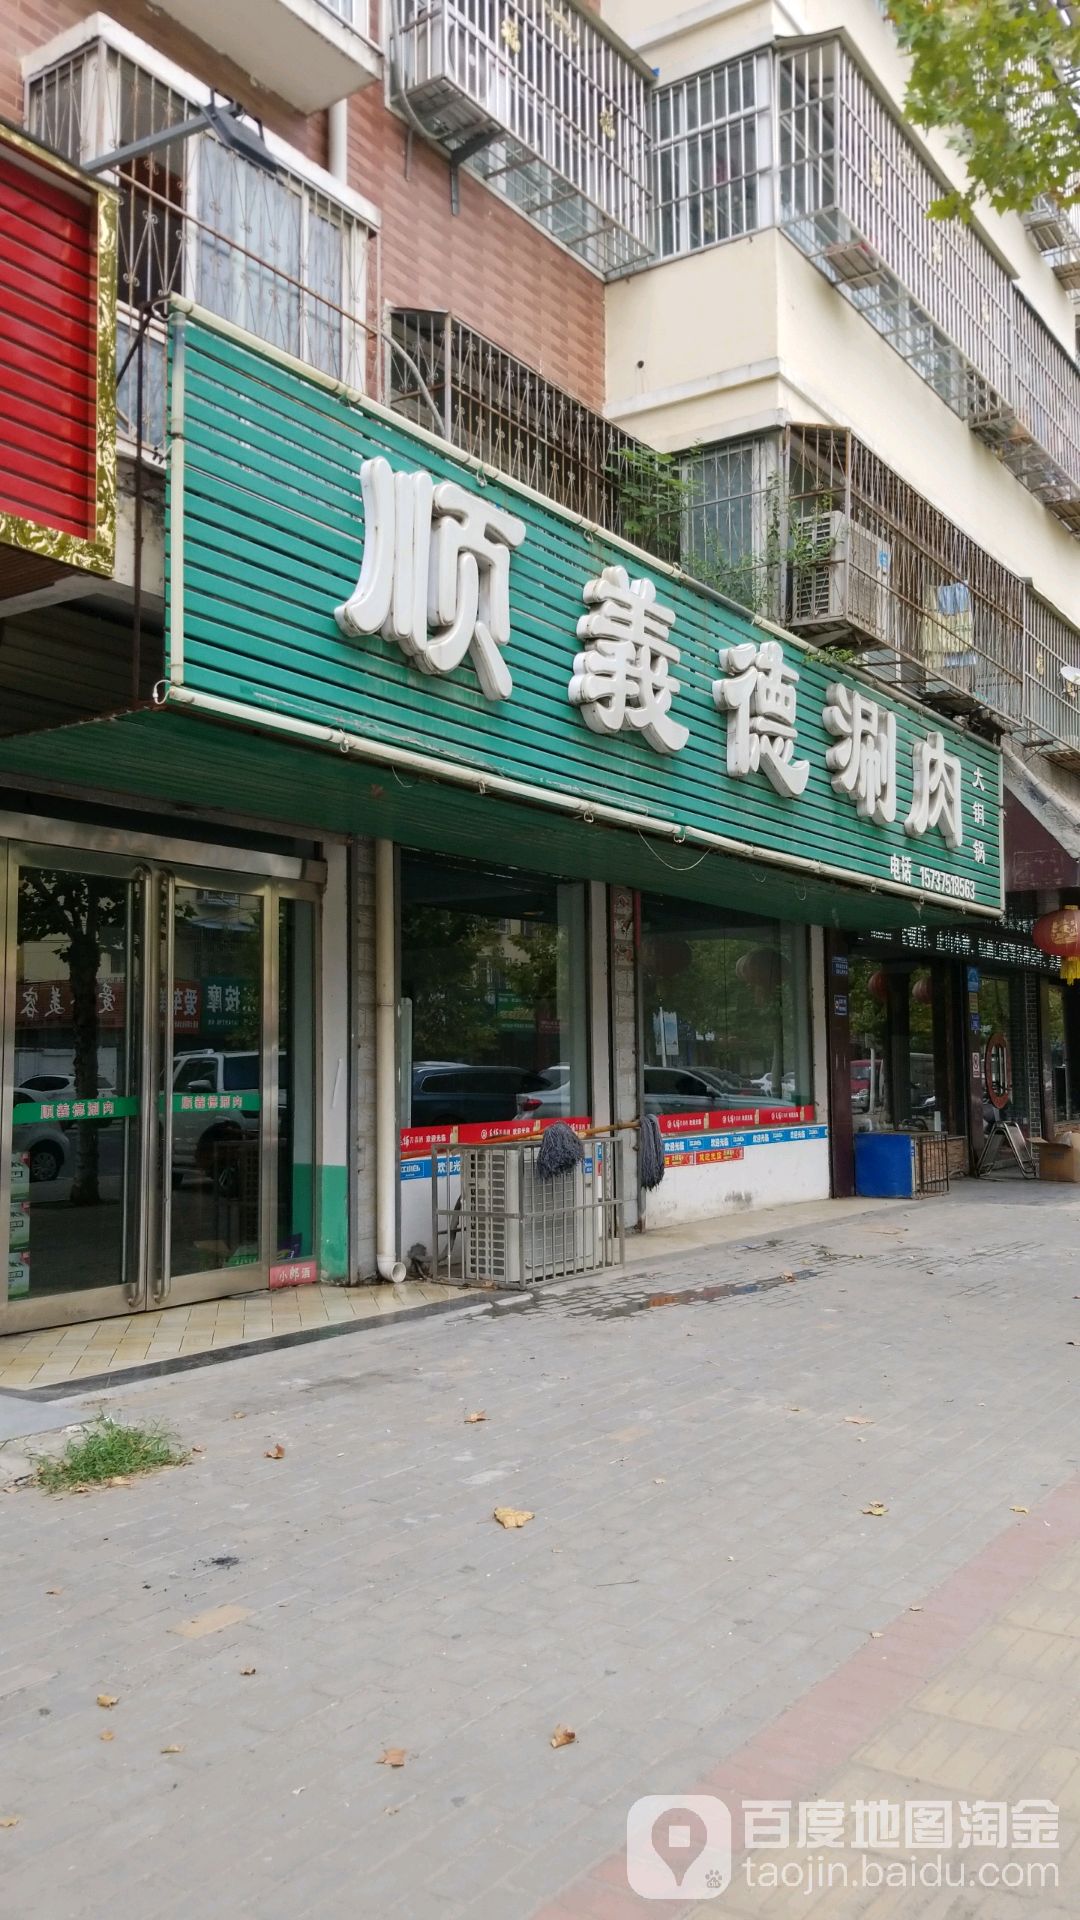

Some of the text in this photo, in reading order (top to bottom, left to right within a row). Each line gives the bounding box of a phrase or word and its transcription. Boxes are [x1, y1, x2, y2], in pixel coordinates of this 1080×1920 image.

[334, 456, 963, 849] 顺義德涮肉
[890, 853, 976, 900] 电话 15737518563
